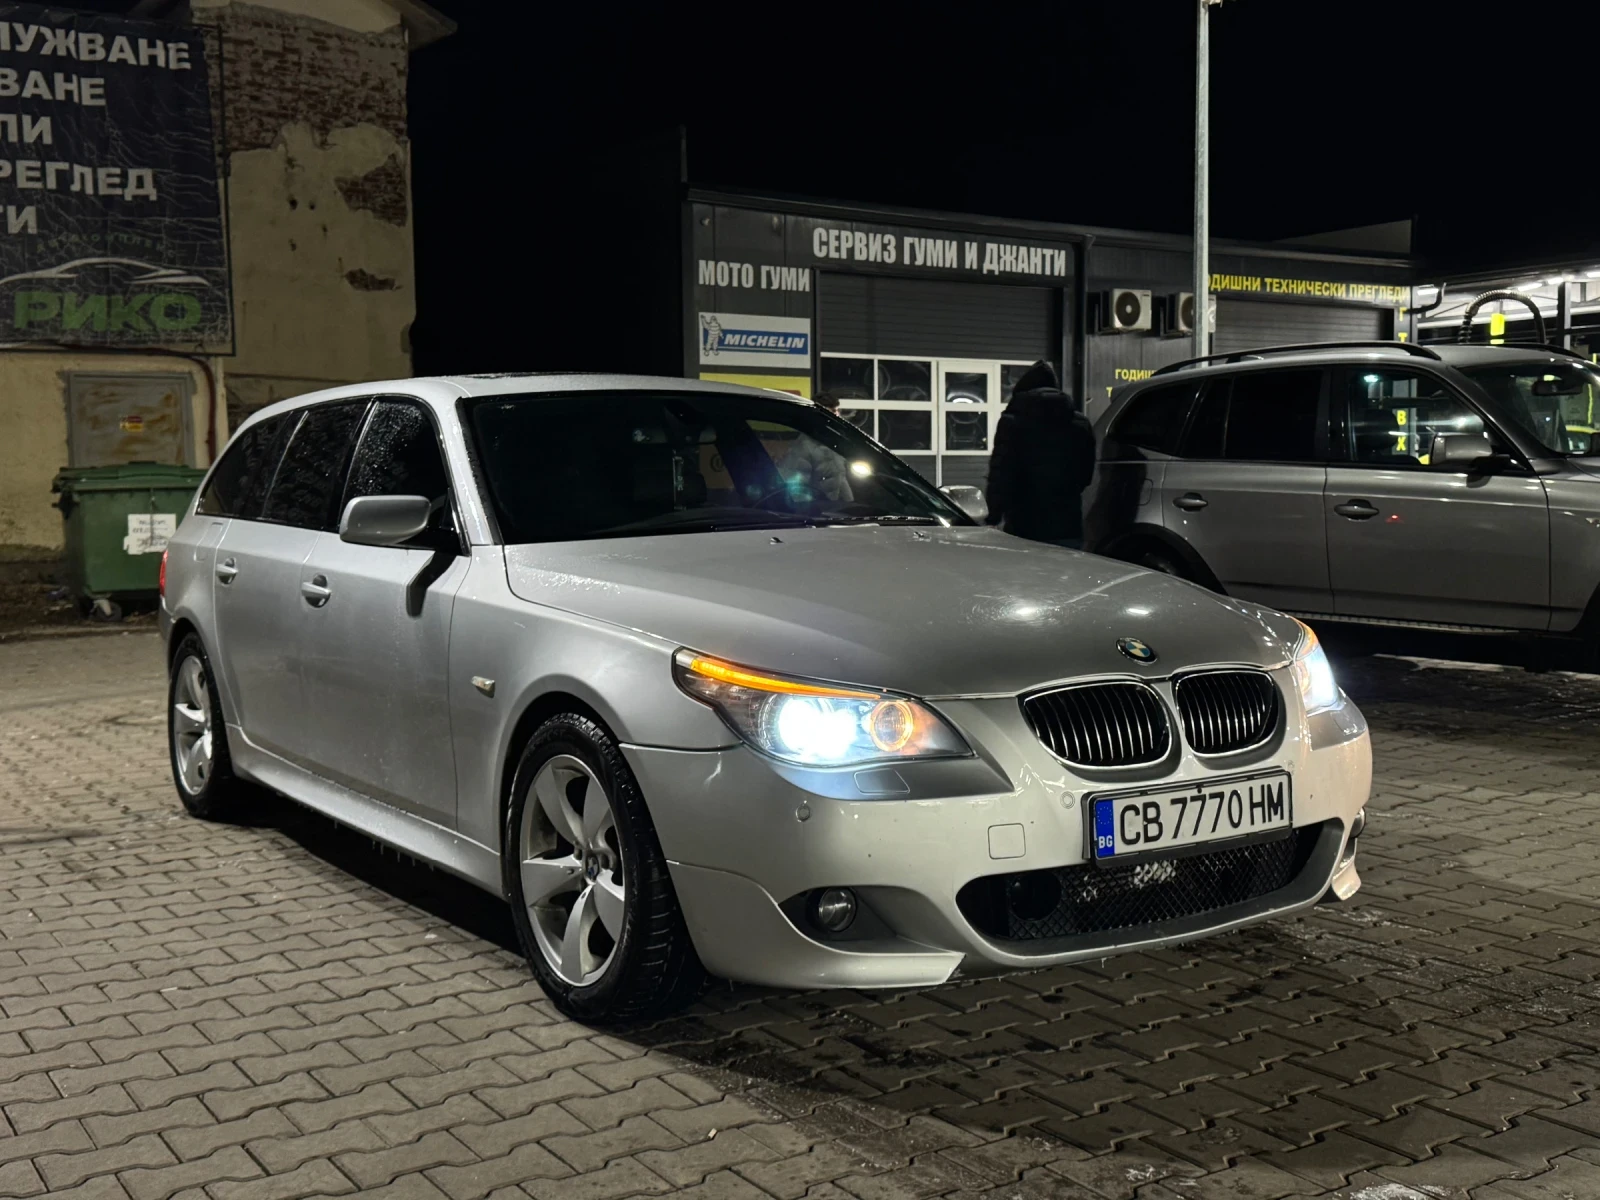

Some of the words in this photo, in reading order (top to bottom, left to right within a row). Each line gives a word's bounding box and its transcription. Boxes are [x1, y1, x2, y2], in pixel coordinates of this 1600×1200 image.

[0, 67, 107, 106] ВАНЕ
[0, 205, 38, 235] И
[813, 227, 896, 264] СЕРВИЗ
[903, 236, 958, 269] ГУМИ
[964, 241, 978, 270] И
[982, 243, 1066, 277] ДЖАНТИ
[698, 259, 754, 288] МОТО
[760, 265, 811, 292] ГУМИ
[1208, 273, 1261, 292] ДИШНИ
[1264, 277, 1347, 298] ТЕХНИЧЕСКИ
[1349, 283, 1411, 303] ПРЕГЛЕДИ
[14, 290, 202, 332] РИКО
[723, 332, 806, 349] MICHELIN
[1115, 368, 1157, 383] ГОДИШ
[1119, 802, 1163, 846] CB
[1170, 789, 1243, 840] 7770
[1249, 781, 1284, 826] HM
[1098, 835, 1113, 849] BG
